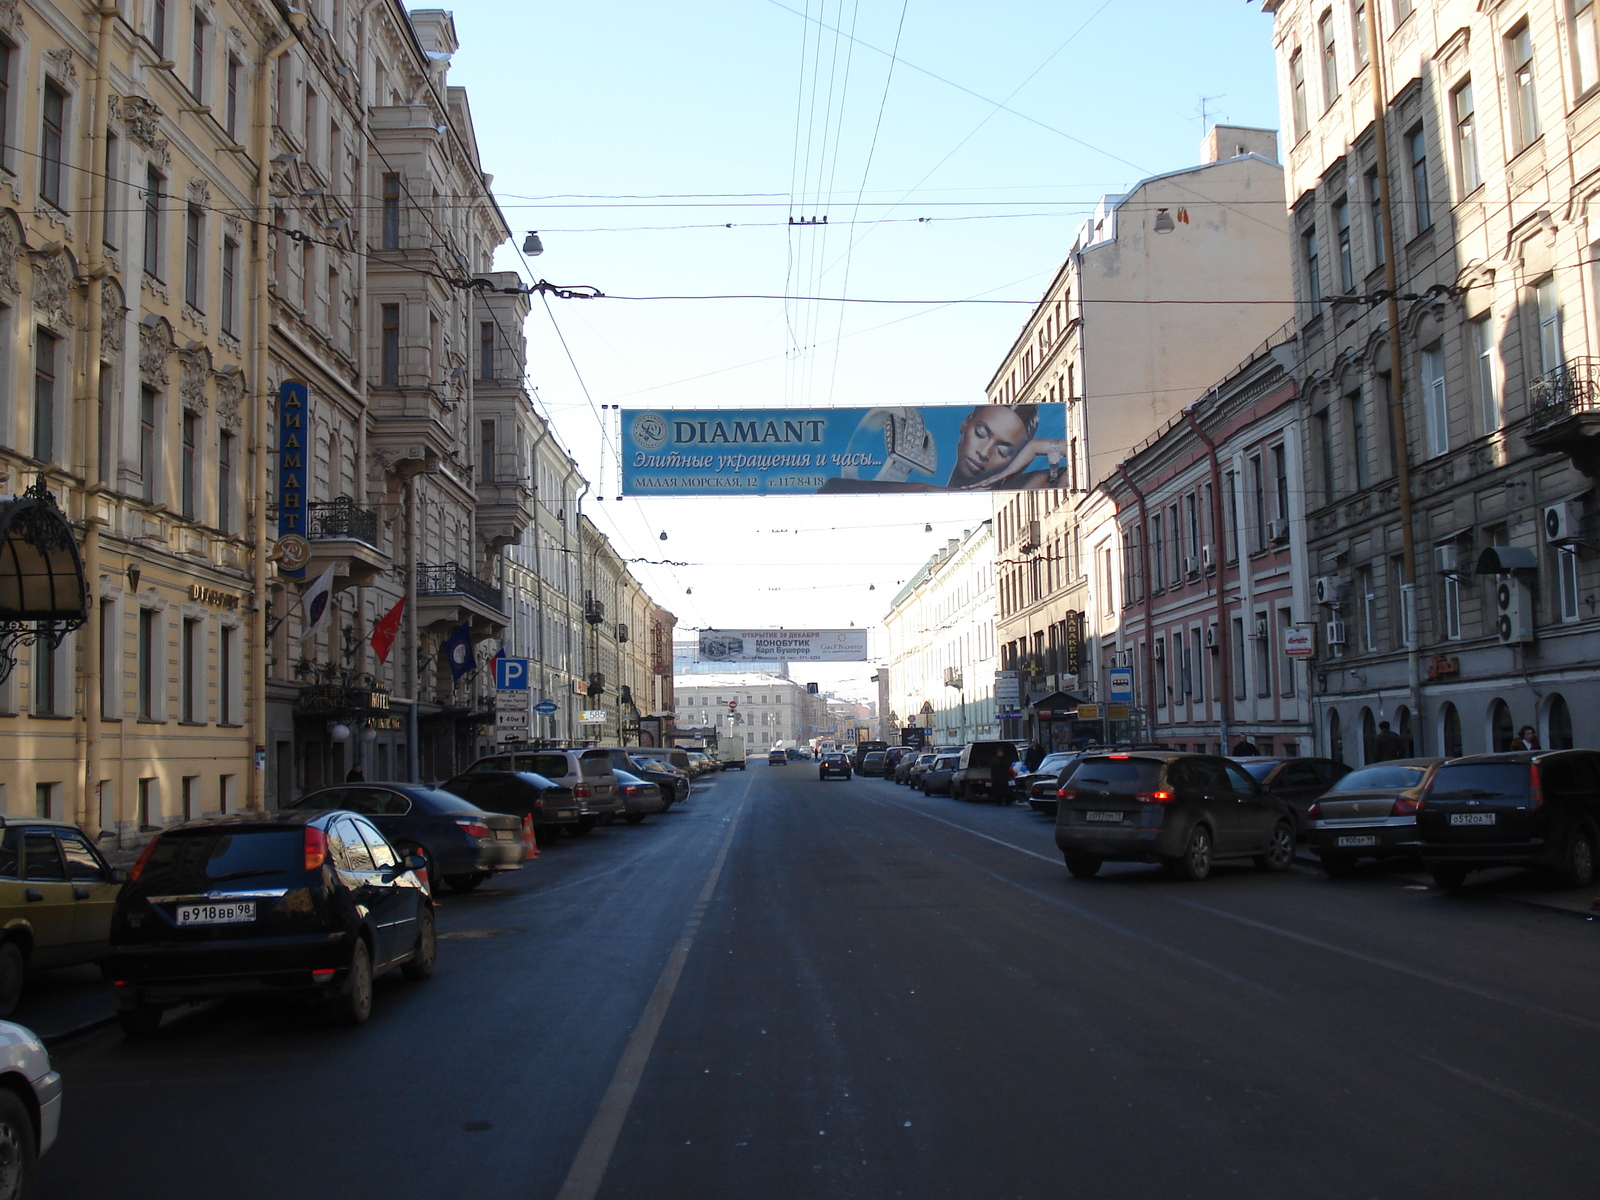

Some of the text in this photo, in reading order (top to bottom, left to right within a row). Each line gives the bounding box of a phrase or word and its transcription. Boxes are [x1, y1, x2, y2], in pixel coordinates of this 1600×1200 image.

[673, 420, 826, 444] DIAMANT
[283, 390, 302, 529] ДИАМАНТ
[633, 450, 713, 468] Элитные
[715, 452, 811, 473] украшения
[815, 454, 827, 466] и
[635, 477, 677, 487] МАЛАЯ
[681, 477, 742, 489] МОРСКАЯ,
[747, 477, 758, 487] 12
[755, 639, 810, 647] МОНОБУТИК
[1067, 613, 1078, 672] ТАБАКЕРКА
[505, 662, 523, 687] P
[304, 698, 348, 708] PALACE
[370, 692, 390, 709] HOTEL
[589, 710, 606, 719] 585
[183, 904, 251, 921] В918ВВ 98
